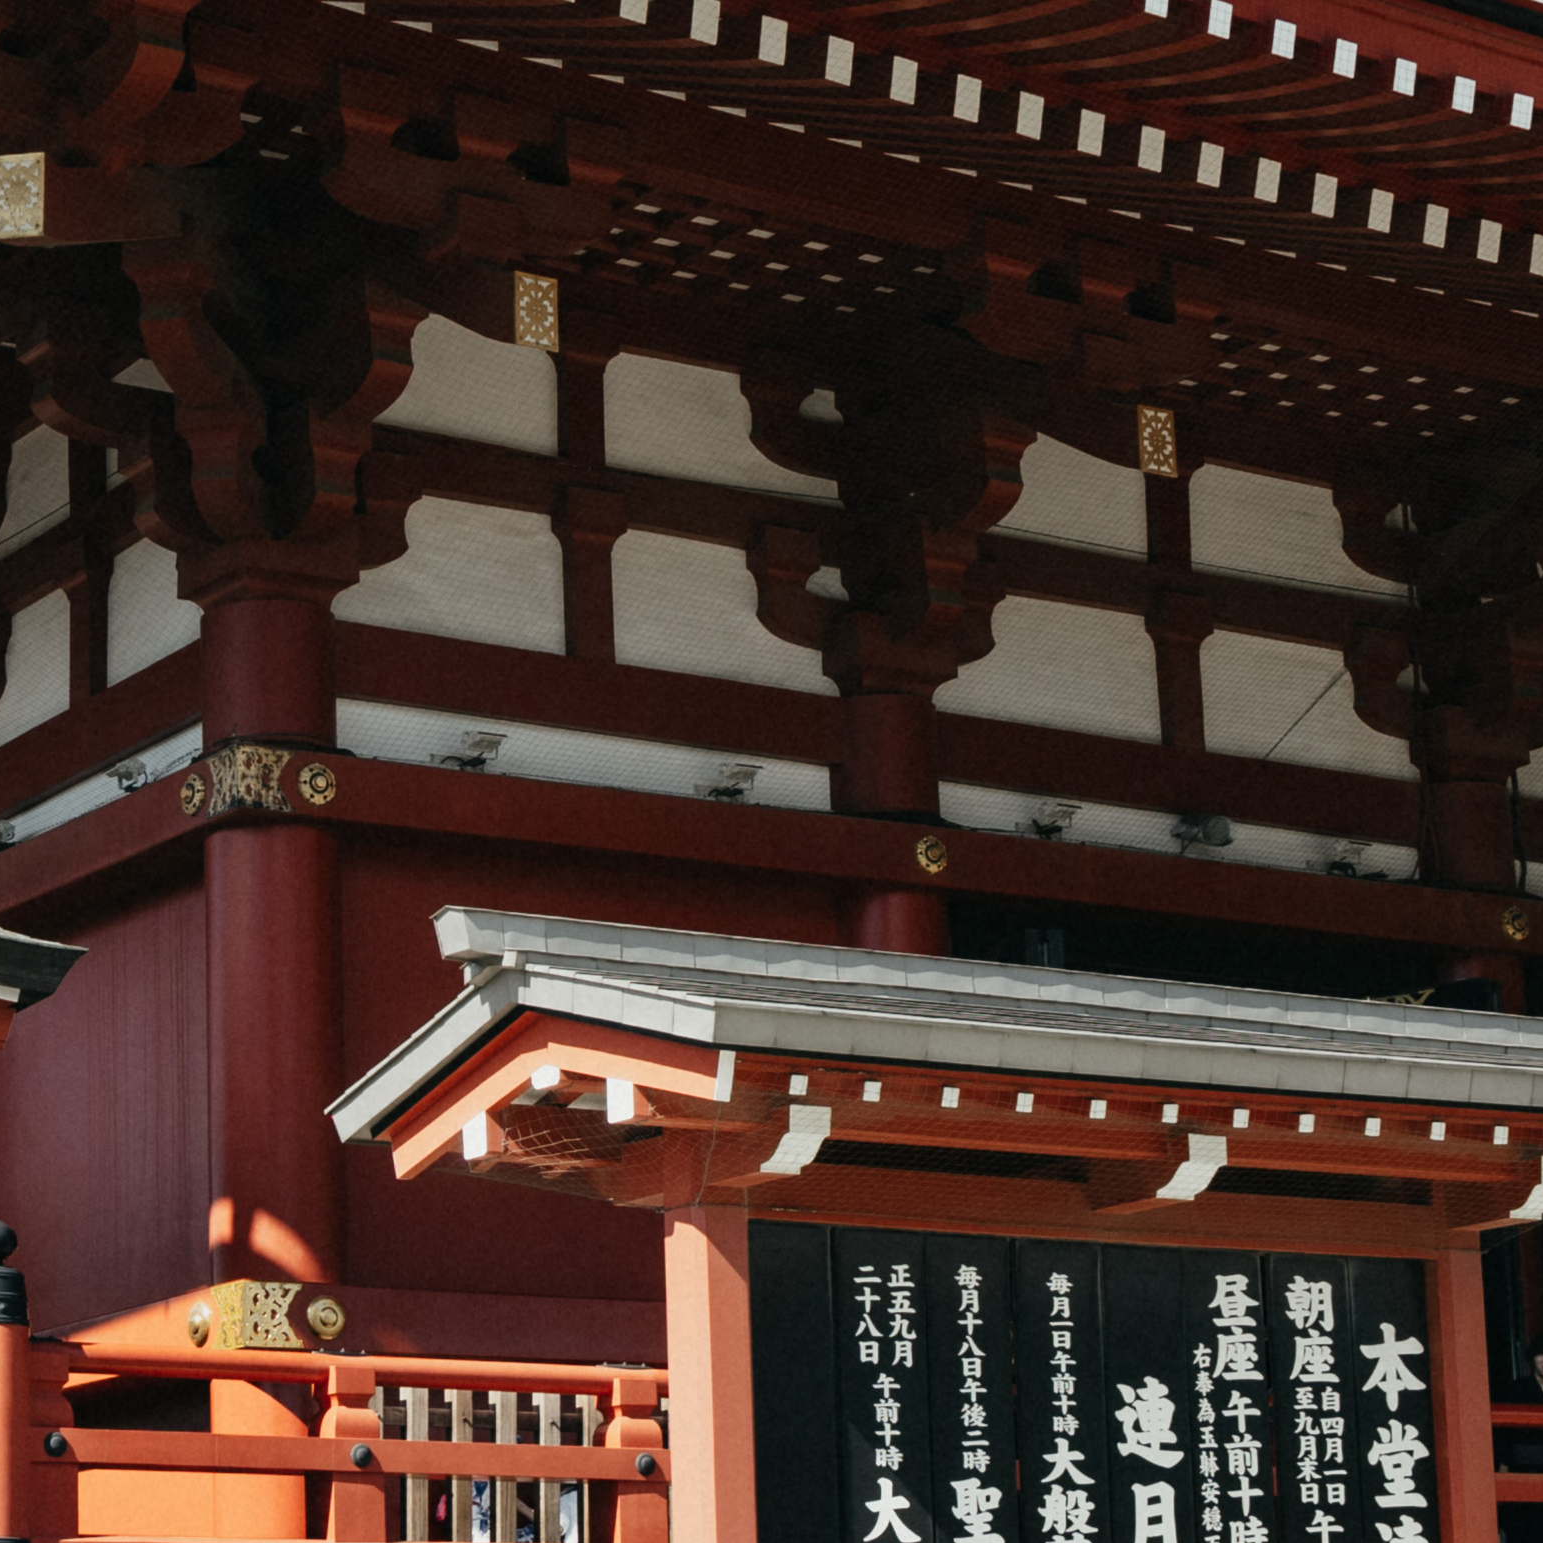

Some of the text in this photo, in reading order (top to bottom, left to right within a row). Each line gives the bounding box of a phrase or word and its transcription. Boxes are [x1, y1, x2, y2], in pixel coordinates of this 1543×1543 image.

[853, 1265, 884, 1365] 二十八日
[886, 1263, 917, 1368] 正五九月
[954, 1264, 991, 1474] 毎月十八日午後二時
[1045, 1271, 1080, 1436] 毎月一日午前十時
[1284, 1275, 1338, 1383] 朝座
[872, 1372, 904, 1471] 午前十時
[1293, 1386, 1320, 1505] 至九月末日
[1318, 1386, 1348, 1506] 自四月一日
